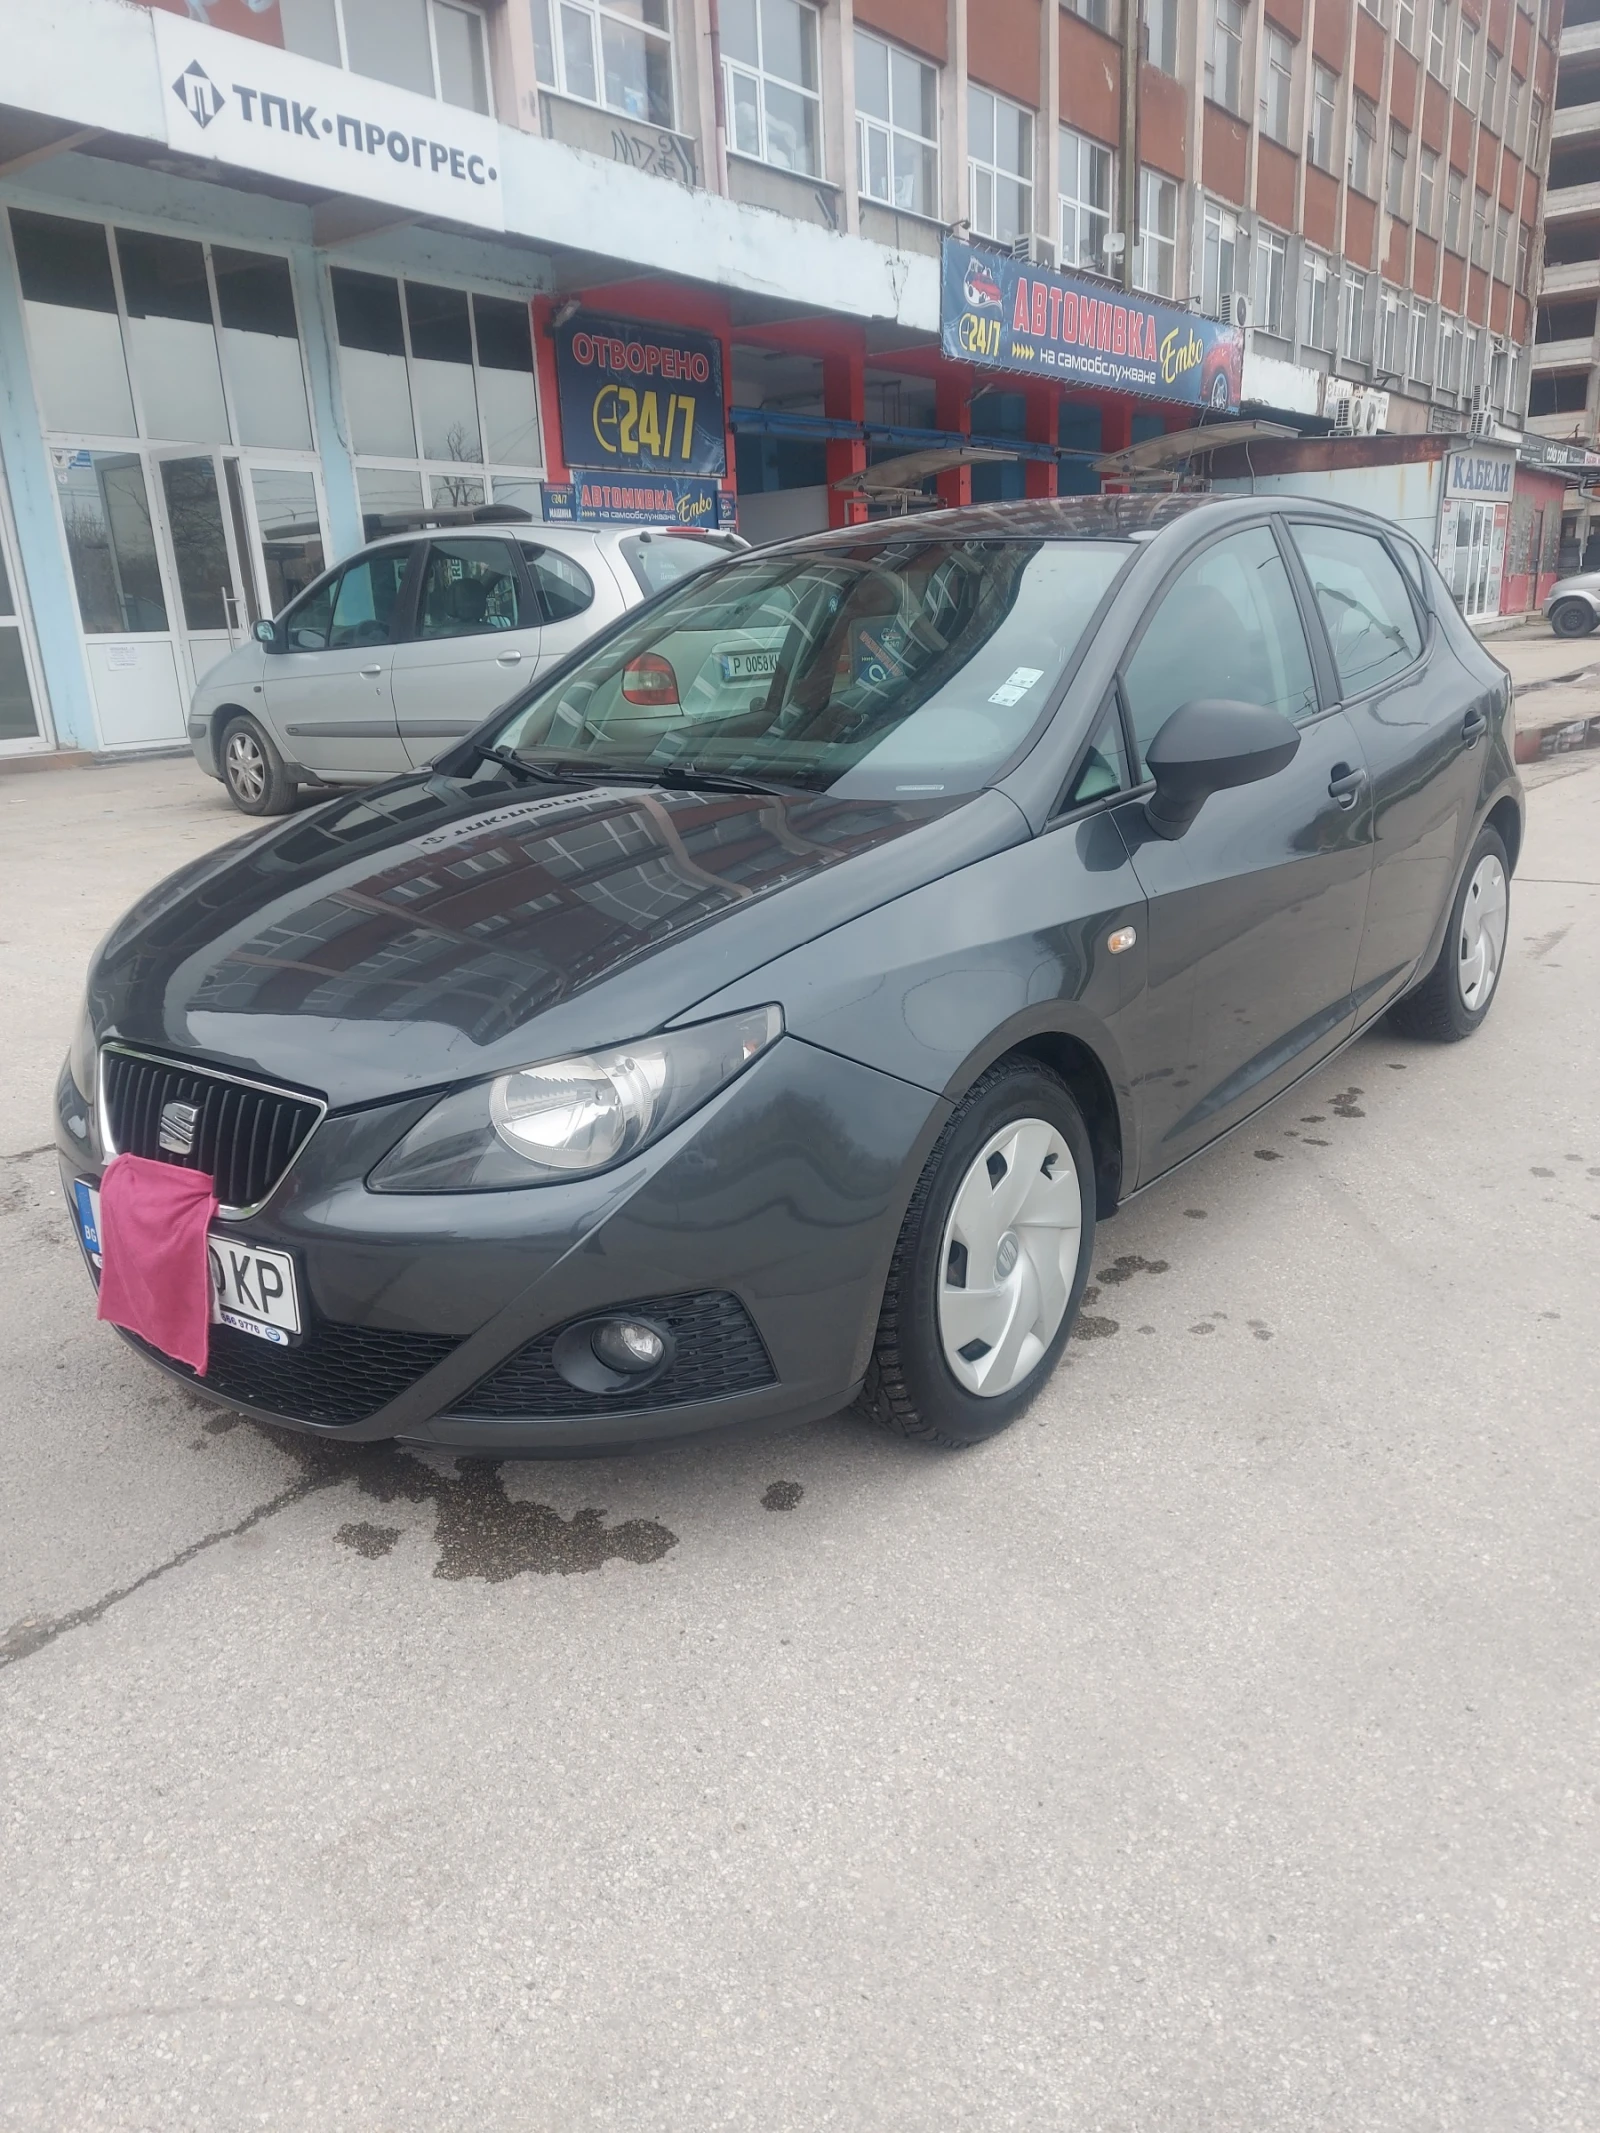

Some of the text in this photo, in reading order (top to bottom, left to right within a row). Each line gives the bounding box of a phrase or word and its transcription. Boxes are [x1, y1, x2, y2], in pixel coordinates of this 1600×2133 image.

[969, 315, 1000, 357] 24/7
[1012, 277, 1157, 362] АВТОМИВКА
[572, 332, 709, 383] ОТВОРЕНО
[1040, 348, 1157, 385] на самообслужване
[618, 387, 696, 459] 24/7
[1452, 455, 1511, 493] КАБЕЛИ
[581, 485, 675, 511] АВТОМИВКА
[599, 511, 676, 522] на самообслужване
[733, 657, 741, 674] P
[84, 1224, 97, 1243] BG
